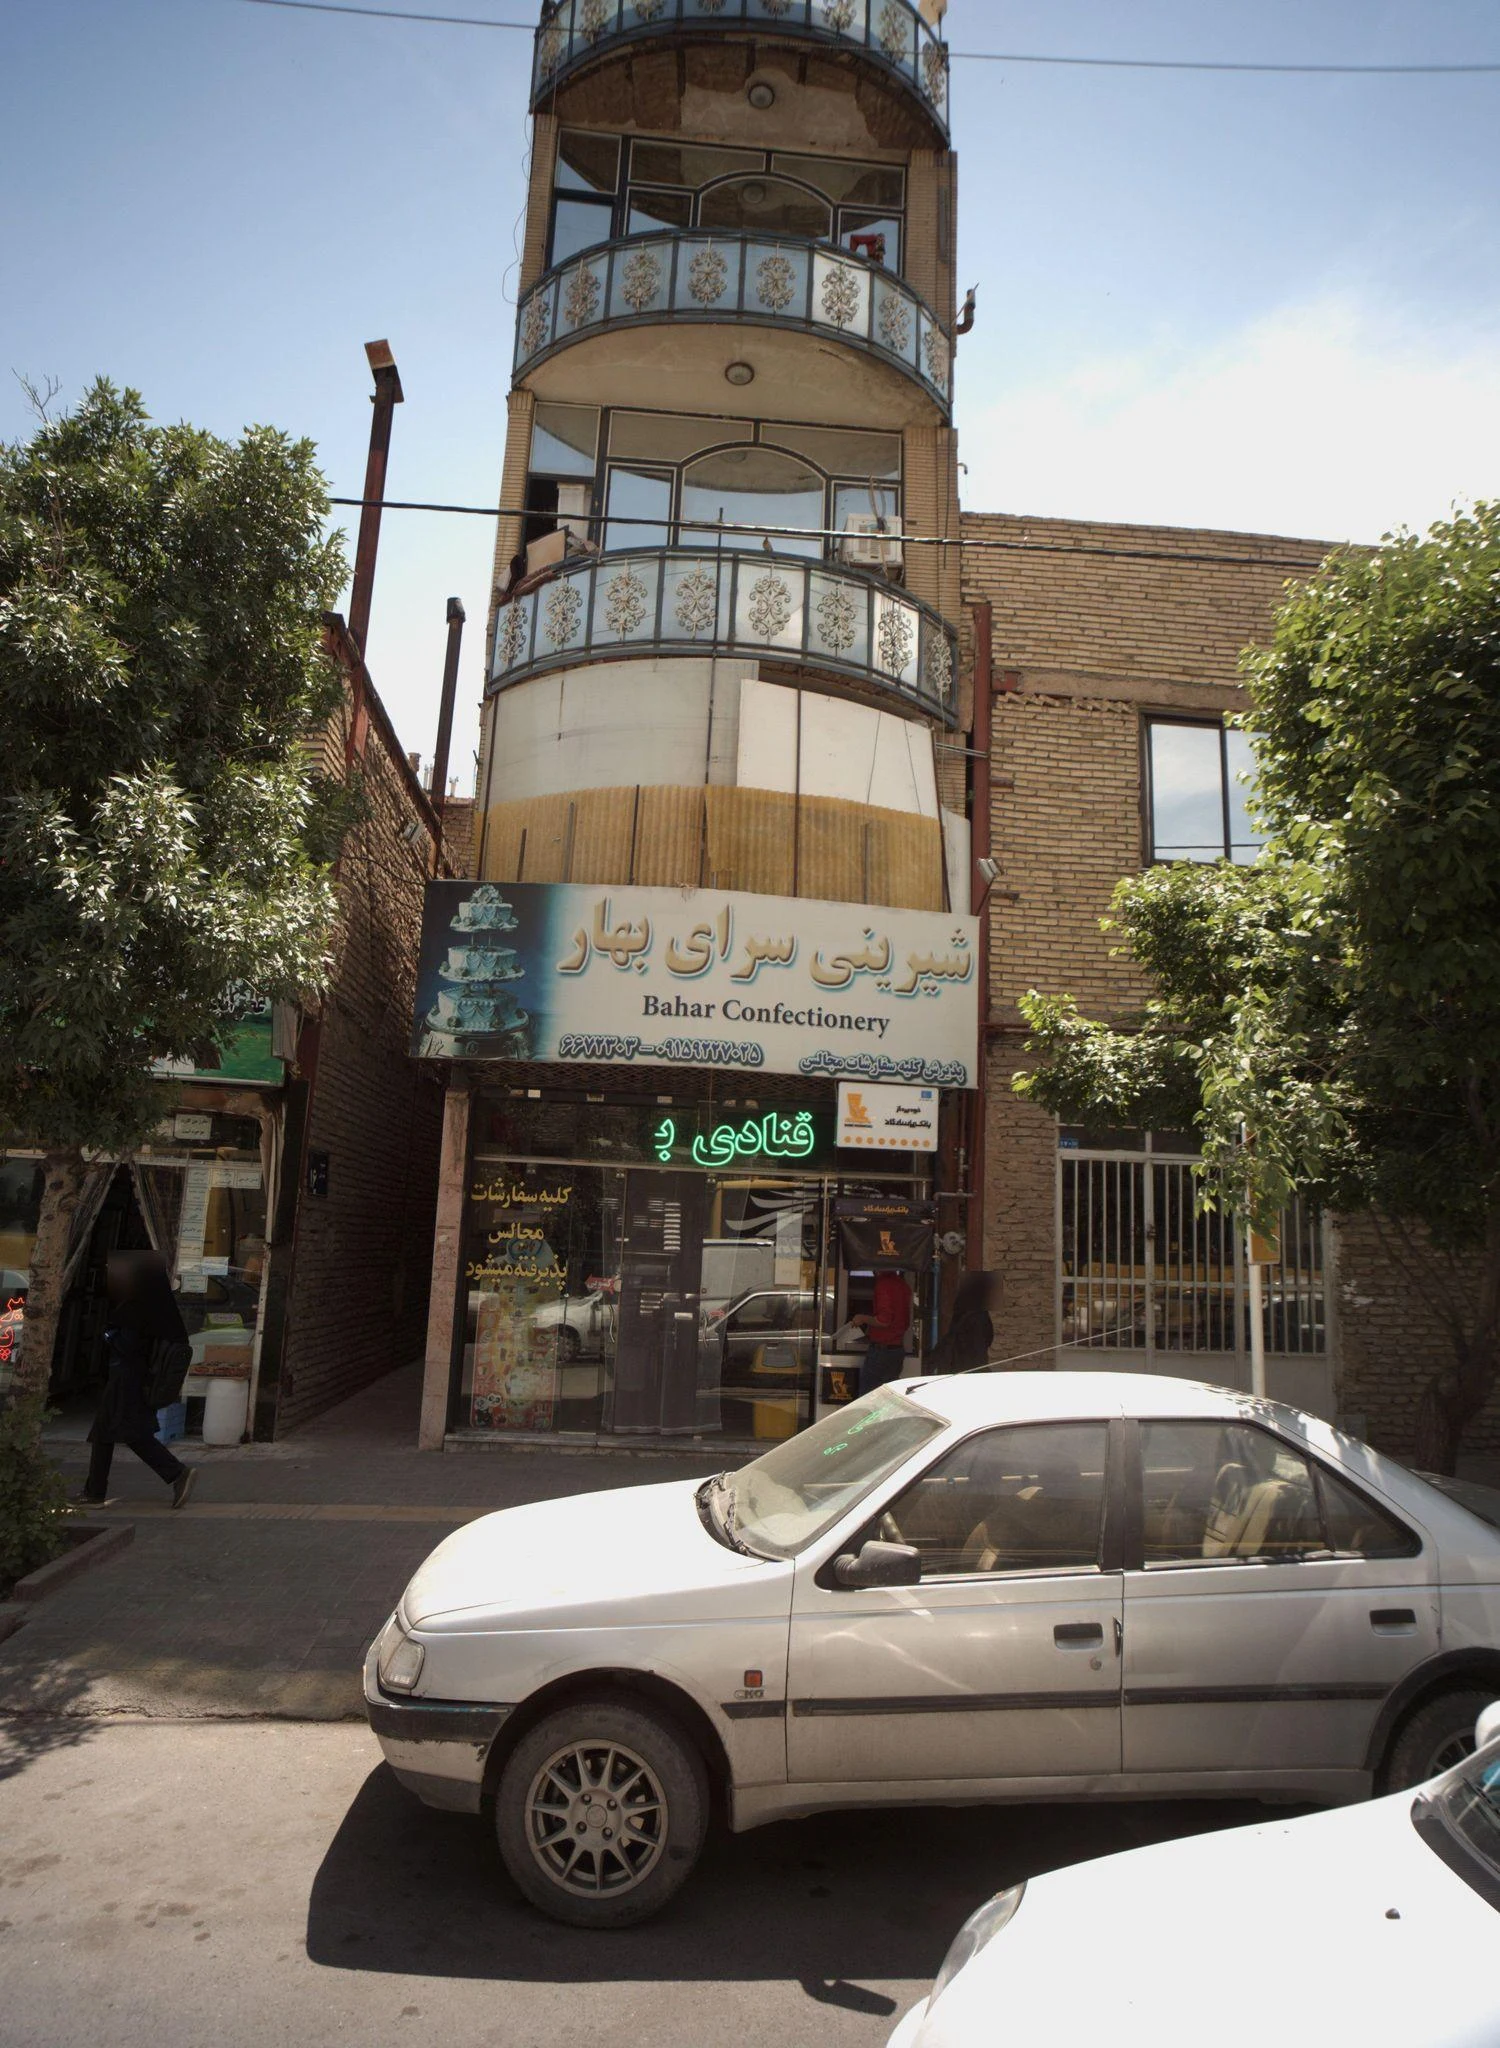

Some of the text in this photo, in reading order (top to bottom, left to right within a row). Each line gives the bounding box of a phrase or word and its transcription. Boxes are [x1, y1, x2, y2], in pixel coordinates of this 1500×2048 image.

[557, 896, 972, 995] شیرینی سرای بهار
[642, 995, 890, 1038] Bahar Confectionery
[800, 1050, 966, 1083] پذیرش کلیه سفارشات مجالس
[691, 1110, 815, 1167] قنادی
[471, 1176, 573, 1212] کلیه سفارشات
[488, 1221, 544, 1247] مجالس
[465, 1252, 569, 1291] پذیرفته میشود
